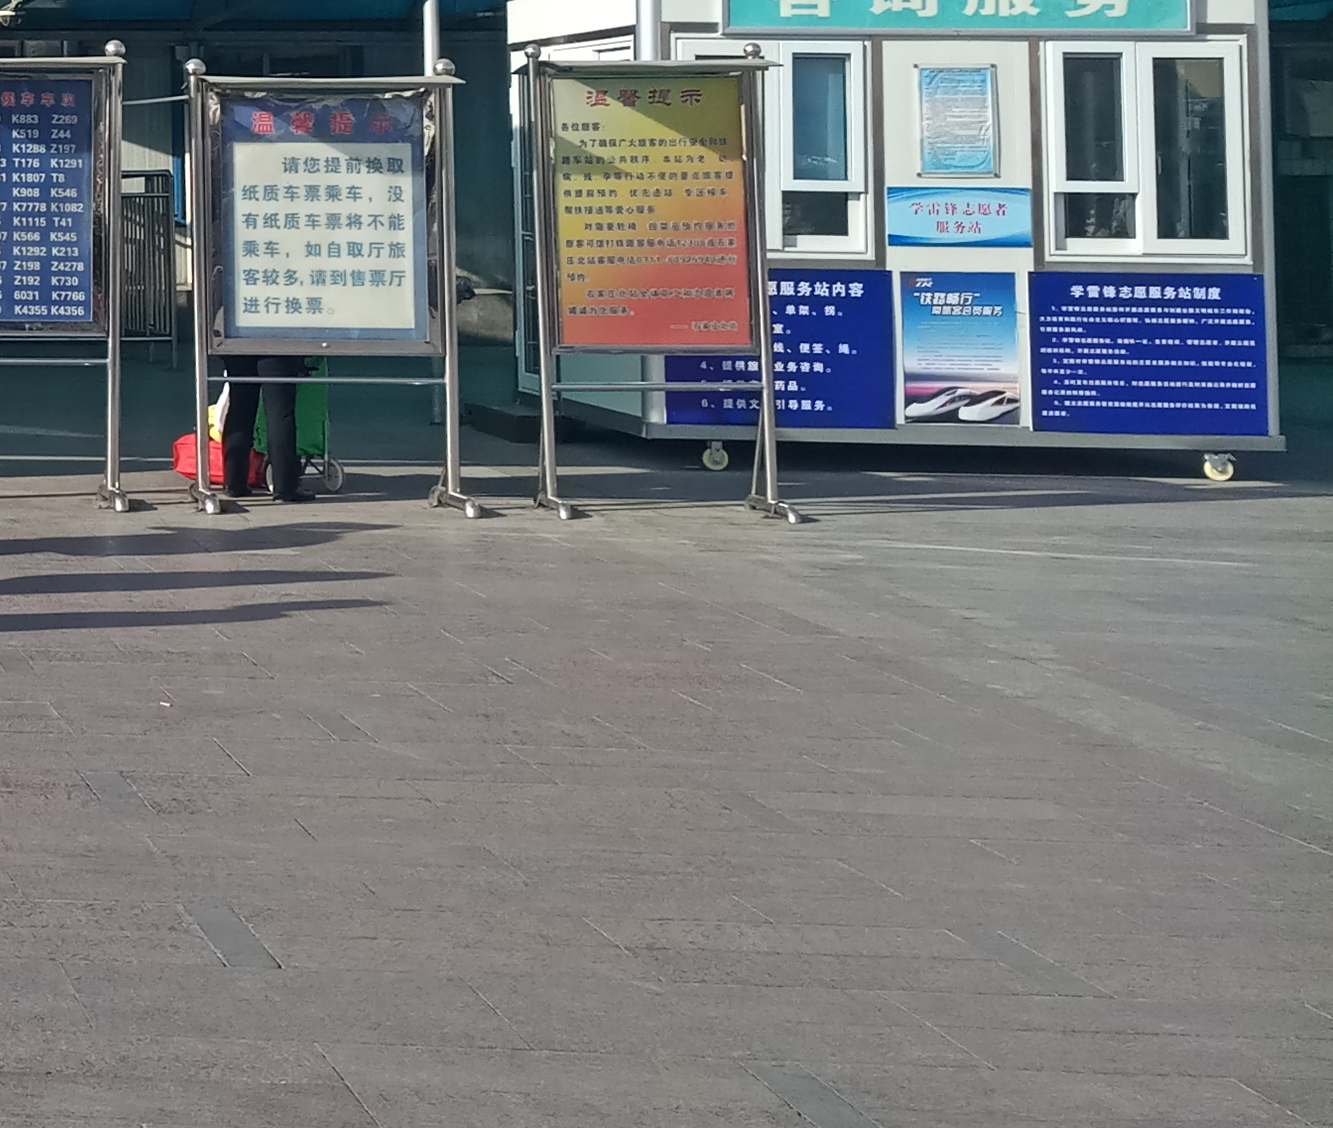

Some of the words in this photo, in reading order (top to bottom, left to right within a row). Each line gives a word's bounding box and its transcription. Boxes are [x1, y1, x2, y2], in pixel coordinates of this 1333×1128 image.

[586, 88, 704, 108] 温馨提示
[251, 111, 394, 135] 温馨提示
[51, 128, 72, 139] Z44
[50, 143, 76, 154] Z197
[50, 157, 83, 168] K1291
[281, 156, 405, 175] 请您提前换取
[12, 172, 46, 183] K1807
[242, 185, 405, 204] 纸质车票乘车，没
[909, 201, 1008, 216] 学雷锋志愿者
[13, 216, 47, 227] K1115
[53, 216, 72, 228] T41
[242, 213, 406, 231] 有纸质车票将不能
[936, 221, 982, 234] 服务站
[50, 231, 78, 242] K545
[13, 245, 48, 257] K1292
[52, 246, 79, 257] K213
[242, 241, 407, 259] 乘车，如自取厅旅
[14, 275, 41, 286] Z192
[52, 275, 79, 286] K730
[1070, 285, 1222, 300] 学雷锋志愿服务站制度
[15, 304, 48, 316] K4355
[242, 296, 336, 315] 进行换票。
